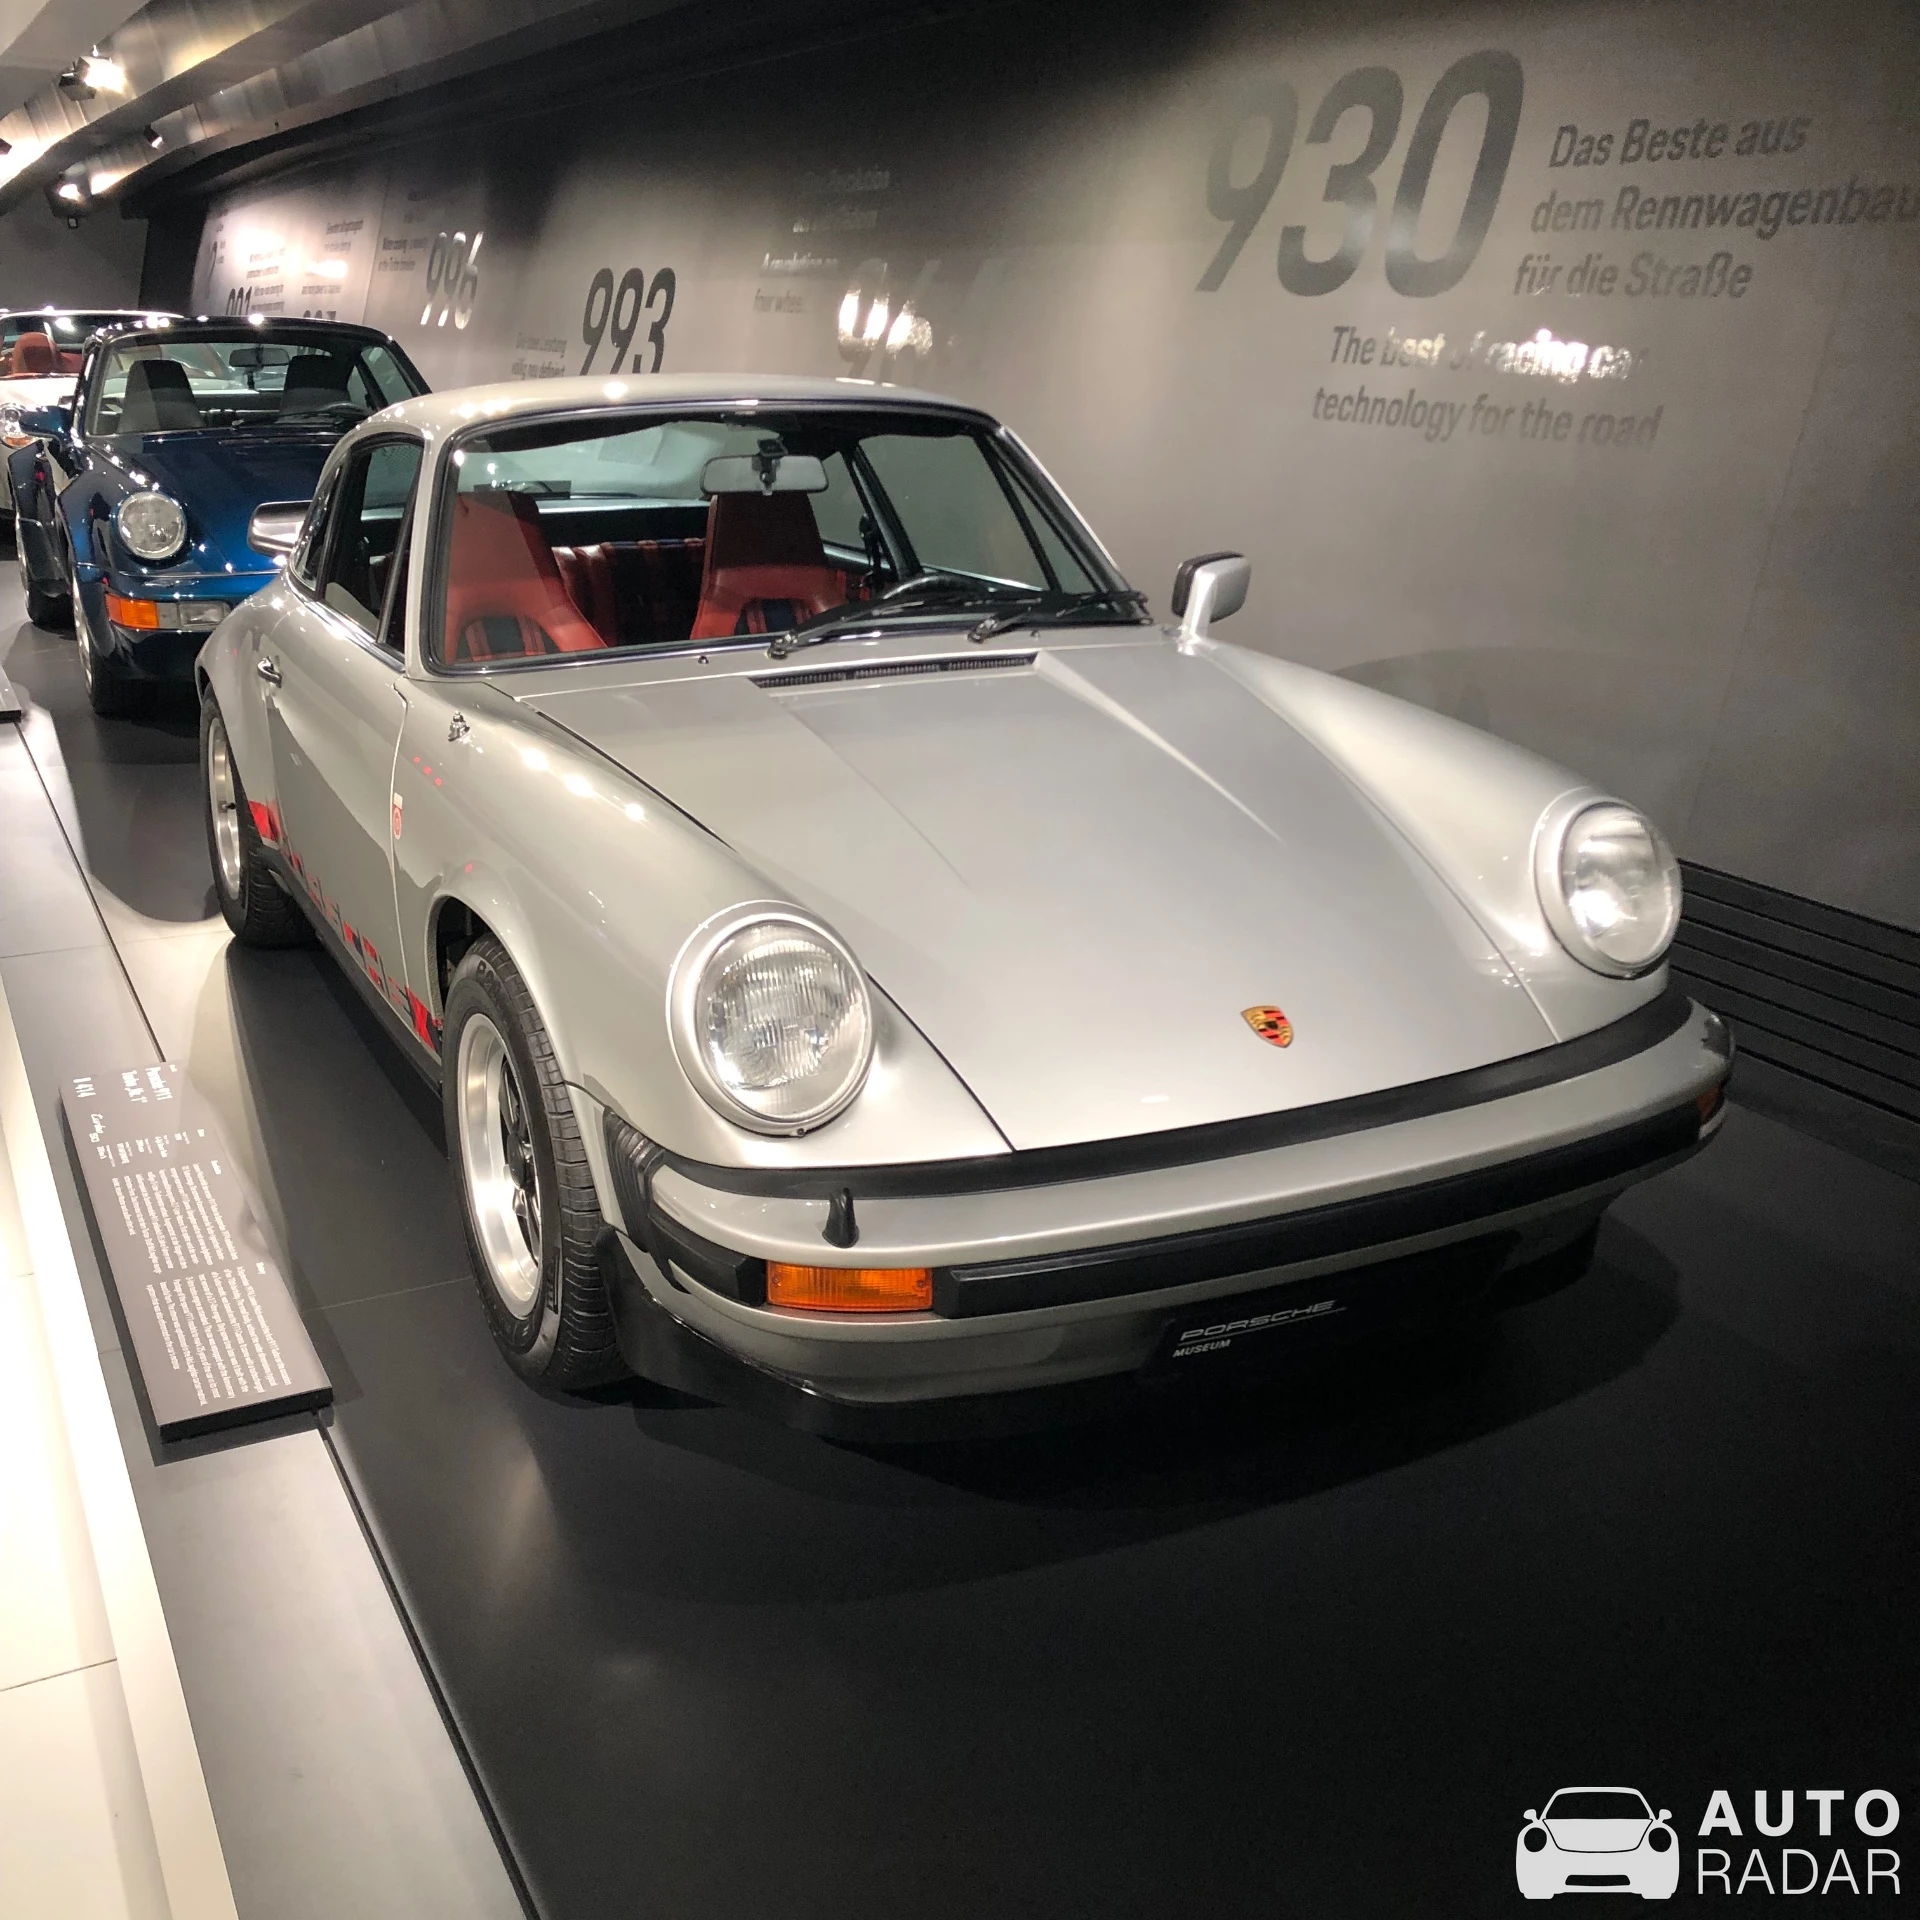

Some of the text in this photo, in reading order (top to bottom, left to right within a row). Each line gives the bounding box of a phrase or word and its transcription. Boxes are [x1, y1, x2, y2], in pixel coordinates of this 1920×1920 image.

[1548, 115, 1812, 169] Das Beste aus
[1195, 49, 1524, 297] 930
[1530, 191, 1602, 234] dem
[420, 231, 484, 330] 996
[1513, 250, 1752, 300] für die Straße
[580, 268, 676, 376] 993
[1331, 325, 1375, 366] The
[1380, 326, 1447, 368] best
[1486, 328, 1588, 385] racing
[1311, 386, 1665, 451] technology for the road
[1172, 1339, 1232, 1358] MUSEUM
[1180, 1300, 1337, 1341] PORSCHE
